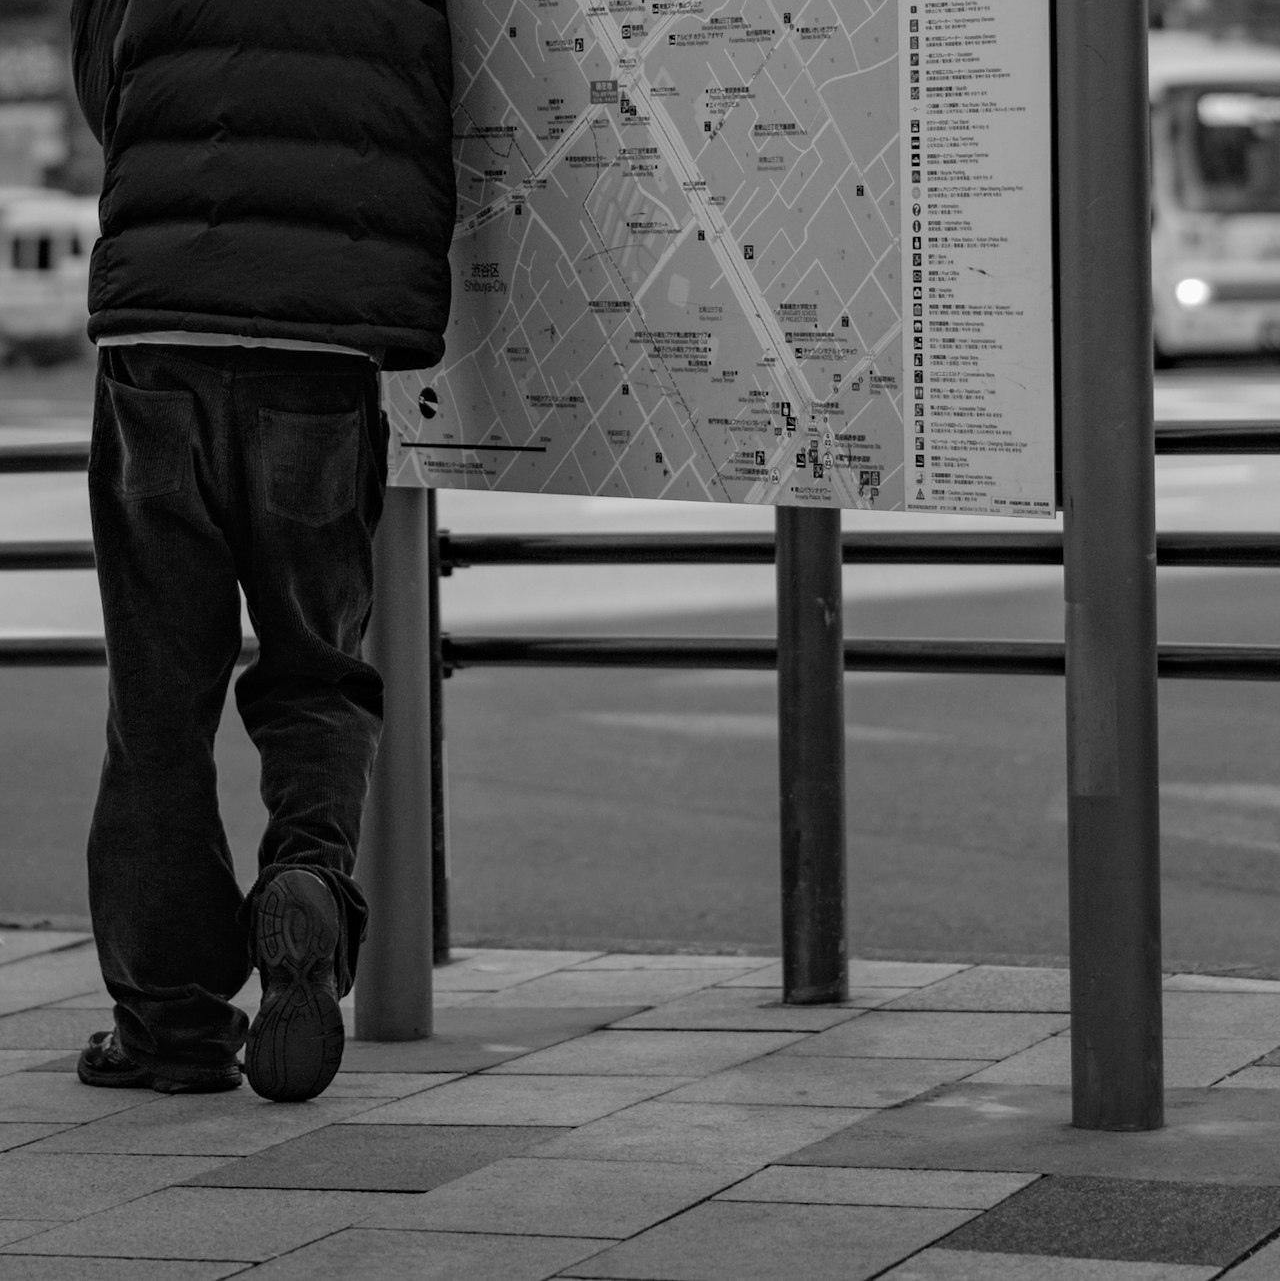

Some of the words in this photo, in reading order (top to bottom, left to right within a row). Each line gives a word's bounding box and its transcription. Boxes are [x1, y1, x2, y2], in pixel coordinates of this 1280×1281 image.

[471, 263, 500, 278] 渋谷区
[464, 280, 507, 295] Shibuya-City
